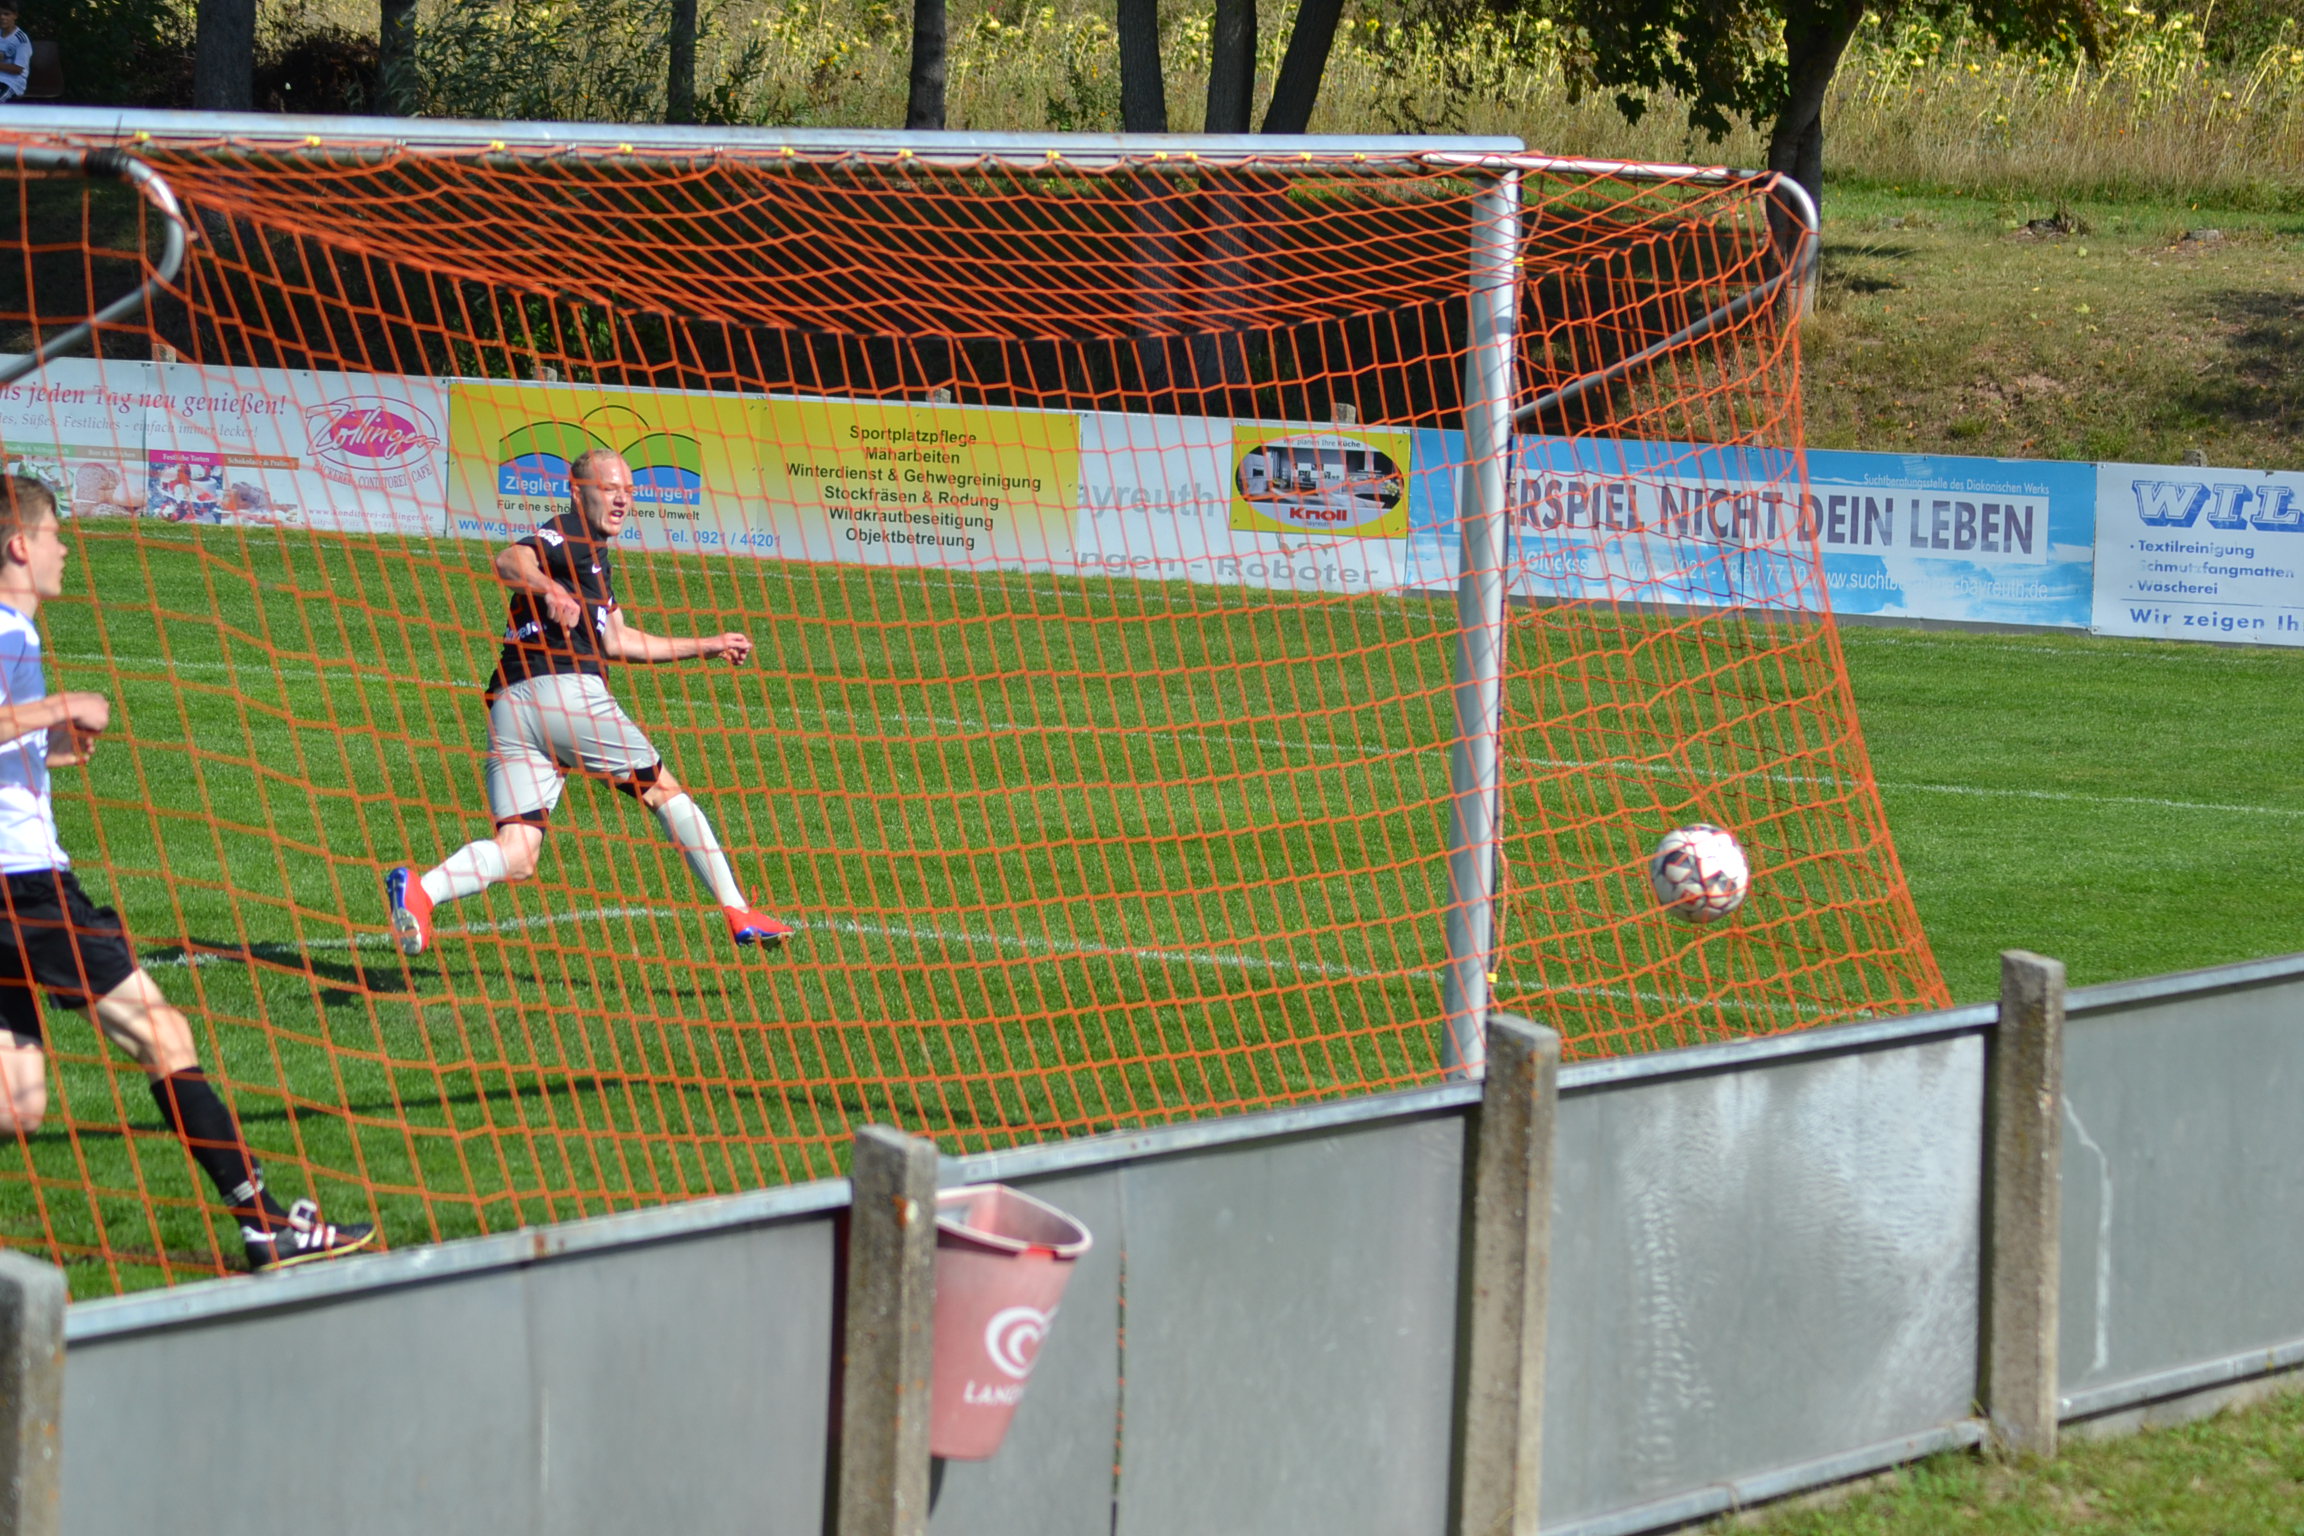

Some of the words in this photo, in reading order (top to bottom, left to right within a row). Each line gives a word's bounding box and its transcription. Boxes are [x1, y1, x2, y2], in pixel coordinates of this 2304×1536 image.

[27, 381, 85, 408] jeden
[94, 384, 132, 414] Tag
[139, 392, 176, 409] neu
[182, 391, 286, 420] genießen!
[850, 425, 977, 447] Sportplatzpflege
[1338, 440, 1361, 448] Küche
[865, 446, 960, 465] Mäharbeiten
[505, 476, 559, 494] Ziegler
[786, 463, 882, 481] Winterdienst
[888, 469, 898, 481] &
[904, 469, 1041, 492] Gehwegreinigung
[1864, 473, 1948, 489] Suchtberatungsstelle
[1950, 478, 1965, 490] des
[1966, 478, 2022, 493] Diakonischen
[2024, 482, 2049, 495] Werks
[824, 486, 917, 503] Stockfräsen
[922, 491, 933, 503] &
[938, 492, 999, 510] Rodung
[497, 500, 515, 511] Für
[518, 503, 542, 512] eine
[544, 503, 572, 513] schö
[658, 509, 700, 520] Umwelt
[828, 508, 994, 531] Wildkrautbeseitigung
[1290, 507, 1347, 521] Knoll
[1660, 484, 1783, 540] NICHT
[1797, 493, 1893, 546] DEIN
[1910, 499, 2034, 554] LEBEN
[664, 528, 688, 542] Tel.
[692, 530, 726, 545] 0921
[740, 533, 780, 547] 44201
[846, 527, 975, 550] Objektbetreuung
[2138, 540, 2255, 559] Textilreinigung
[1076, 551, 1175, 573] ngen
[1217, 555, 1379, 585] Roboter
[2130, 608, 2171, 624] Wir
[2184, 612, 2265, 631] zeigen
[2278, 615, 2304, 631] Ih
